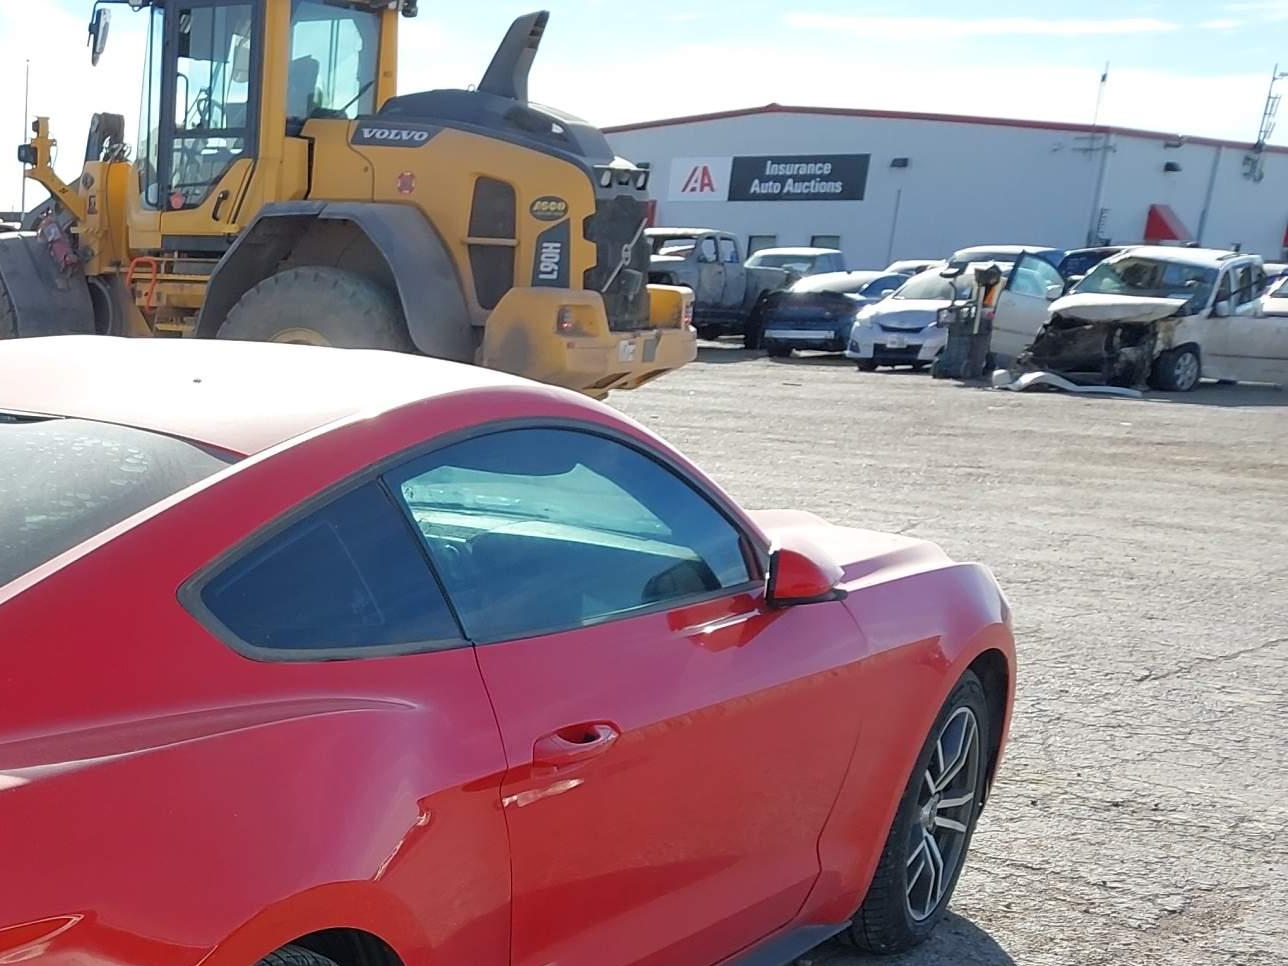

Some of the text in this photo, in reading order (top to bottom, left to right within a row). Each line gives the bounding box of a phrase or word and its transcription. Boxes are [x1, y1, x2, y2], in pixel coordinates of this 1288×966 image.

[362, 128, 429, 141] VOLVO
[765, 160, 832, 176] Insurance
[750, 178, 843, 195] Auto Auctions
[538, 242, 562, 279] L90H
